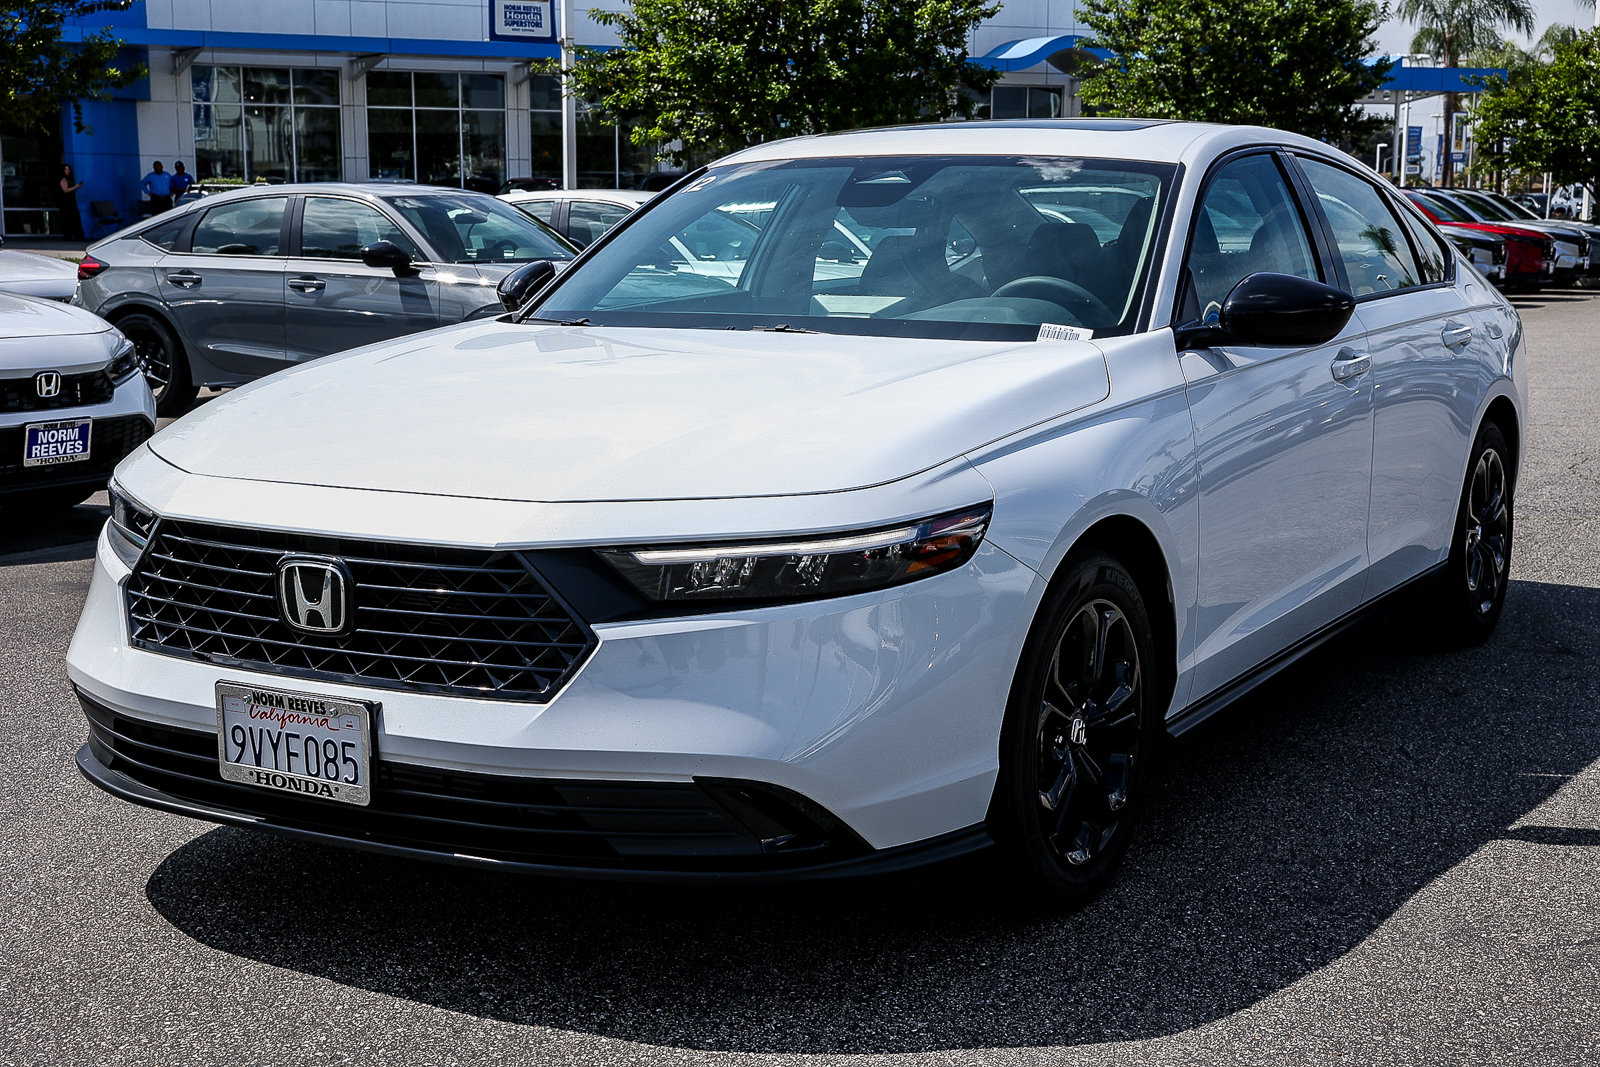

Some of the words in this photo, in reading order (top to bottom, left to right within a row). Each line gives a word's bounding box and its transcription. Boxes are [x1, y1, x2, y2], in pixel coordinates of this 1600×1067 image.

[504, 20, 543, 28] SUPERSTORE
[506, 12, 540, 20] Honda
[38, 428, 79, 444] NORM
[32, 440, 83, 458] REEVES
[39, 455, 76, 465] HONDA
[252, 691, 285, 709] NORM
[288, 698, 326, 715] REEVES
[249, 705, 340, 731] California
[231, 724, 359, 786] 9VYF085
[255, 770, 335, 798] HONDA
